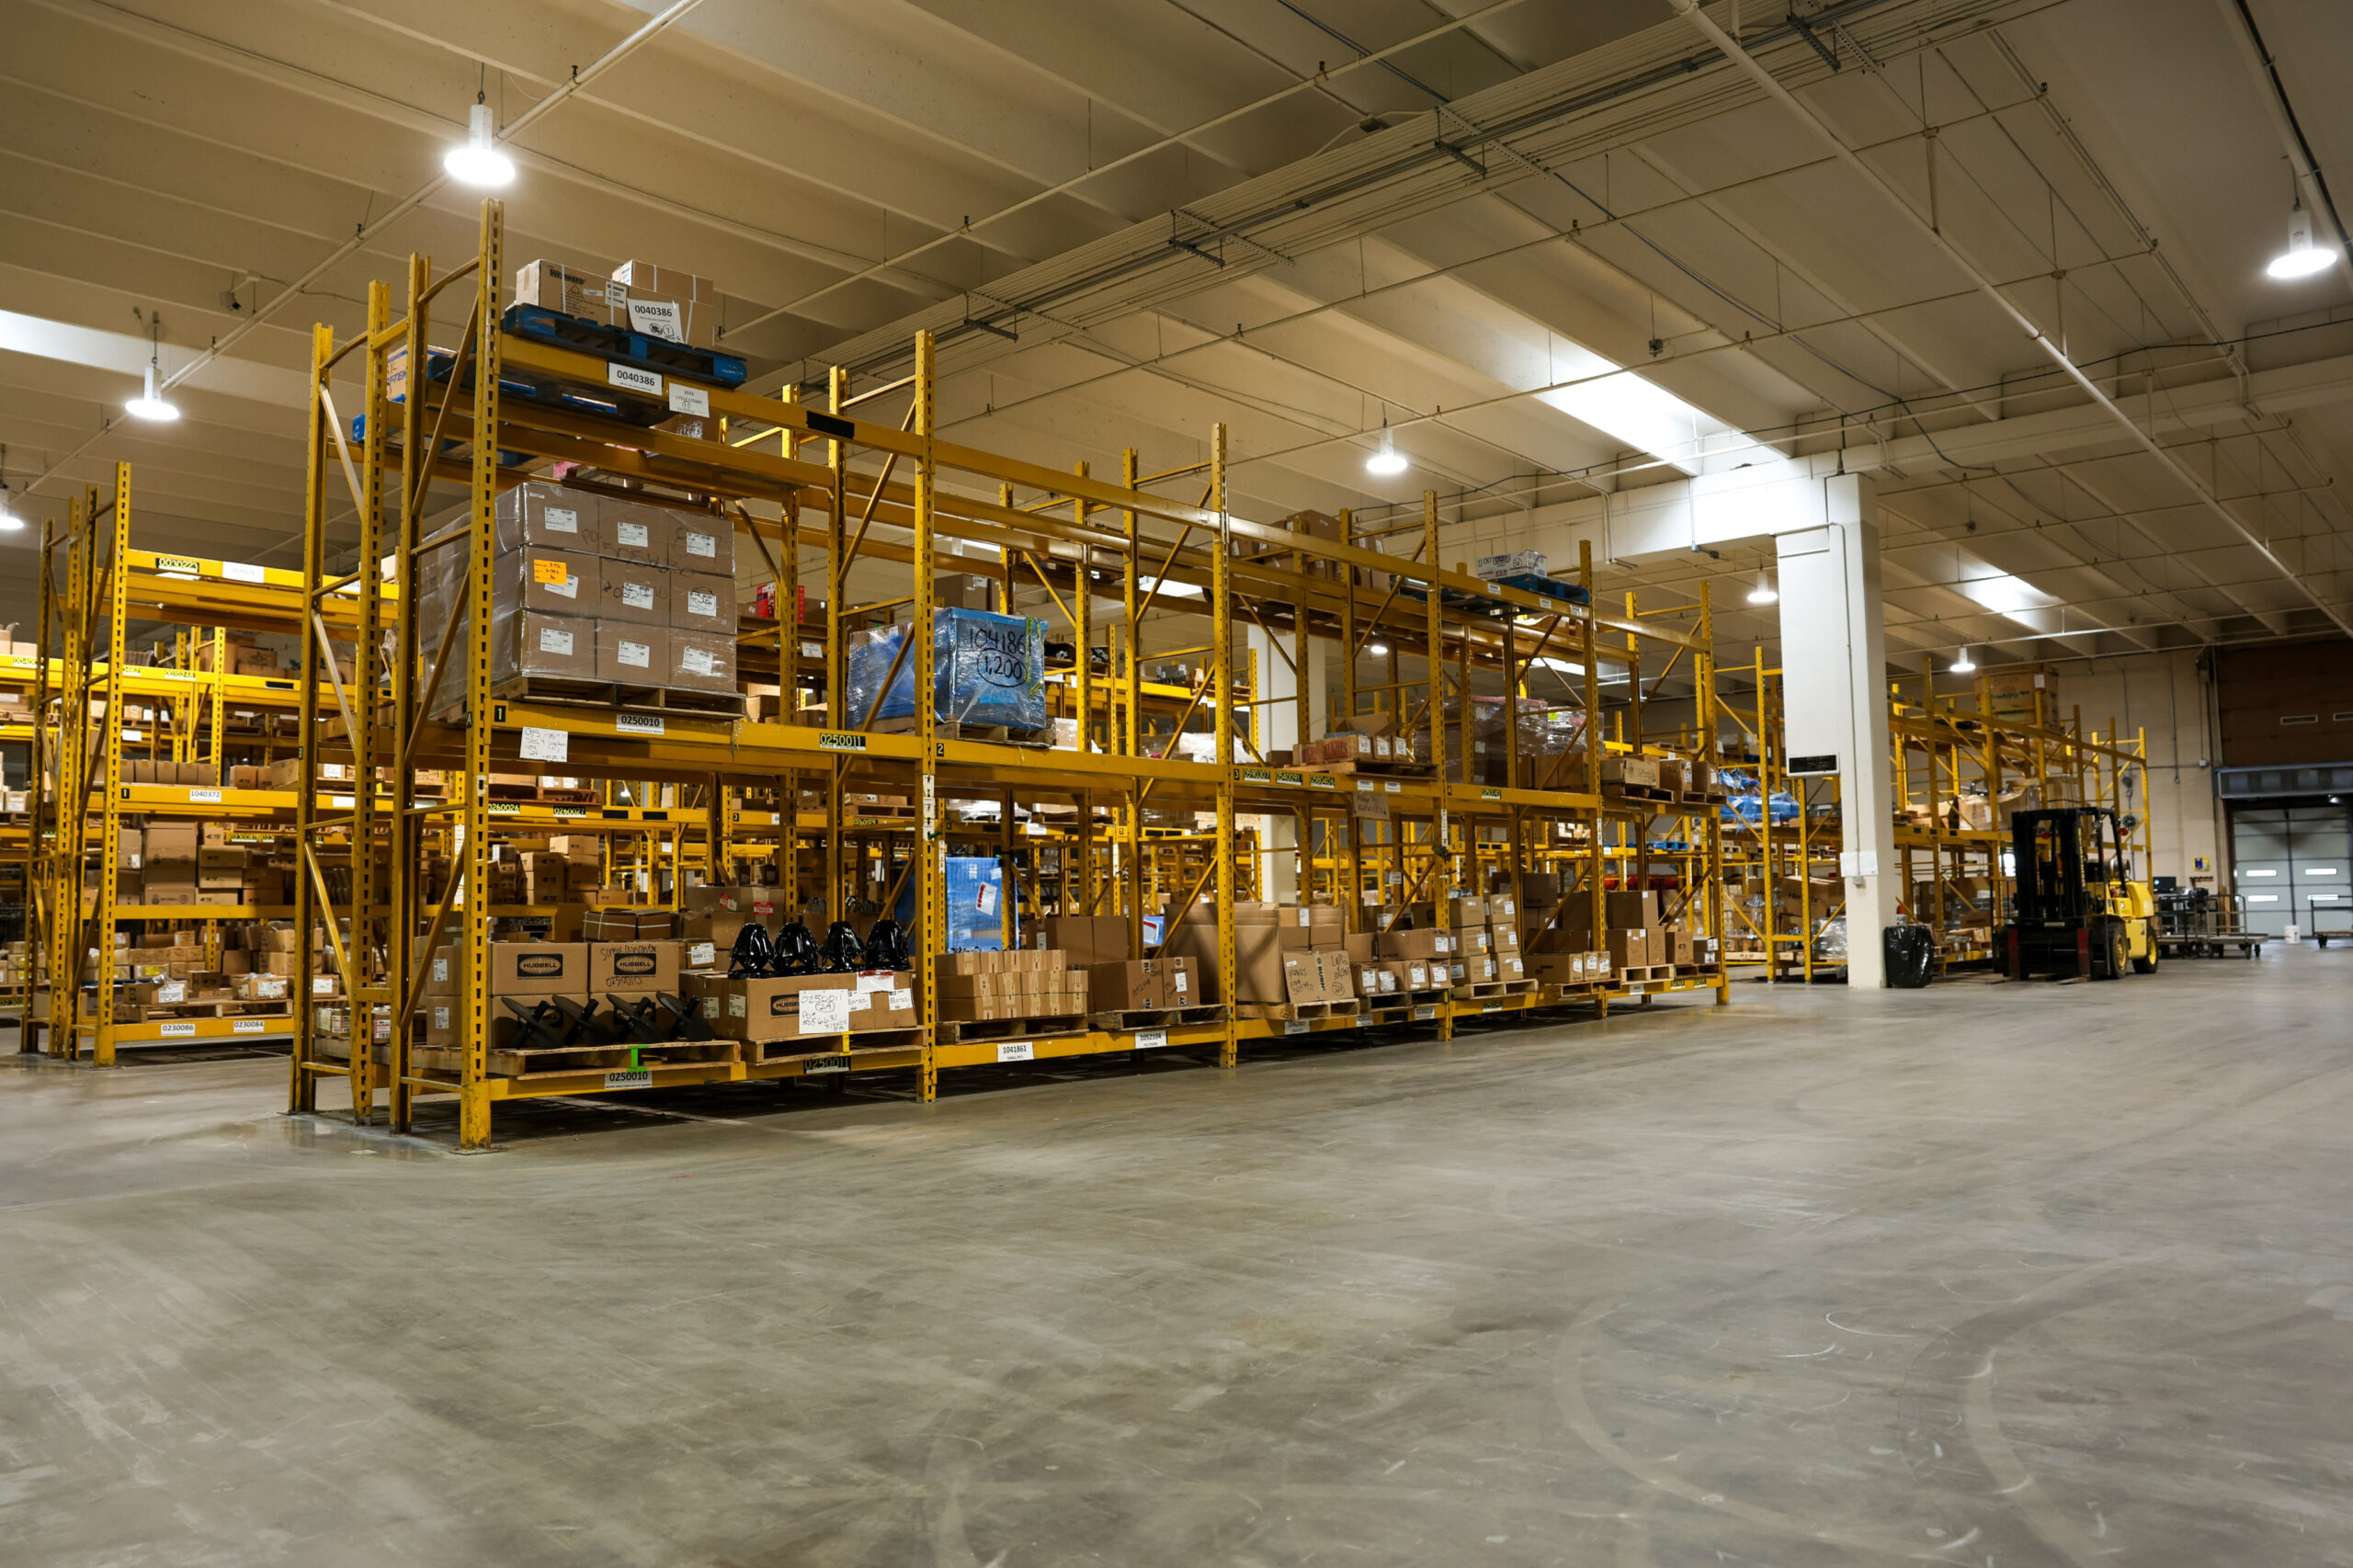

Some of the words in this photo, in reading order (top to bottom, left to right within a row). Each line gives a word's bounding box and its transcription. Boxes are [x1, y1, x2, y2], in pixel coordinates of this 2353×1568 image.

[634, 304, 673, 317] 0040386
[617, 369, 655, 386] 0040386
[984, 656, 1023, 679] 1,200
[497, 708, 503, 721] 1
[621, 715, 660, 727] 0250010
[820, 733, 862, 746] 0250011
[938, 744, 943, 755] 2
[190, 790, 221, 799] 1040372
[801, 994, 842, 1004] 0250011
[1003, 1045, 1028, 1054] 1041861
[804, 1057, 849, 1070] 0250011
[609, 1071, 648, 1082] 0250010
